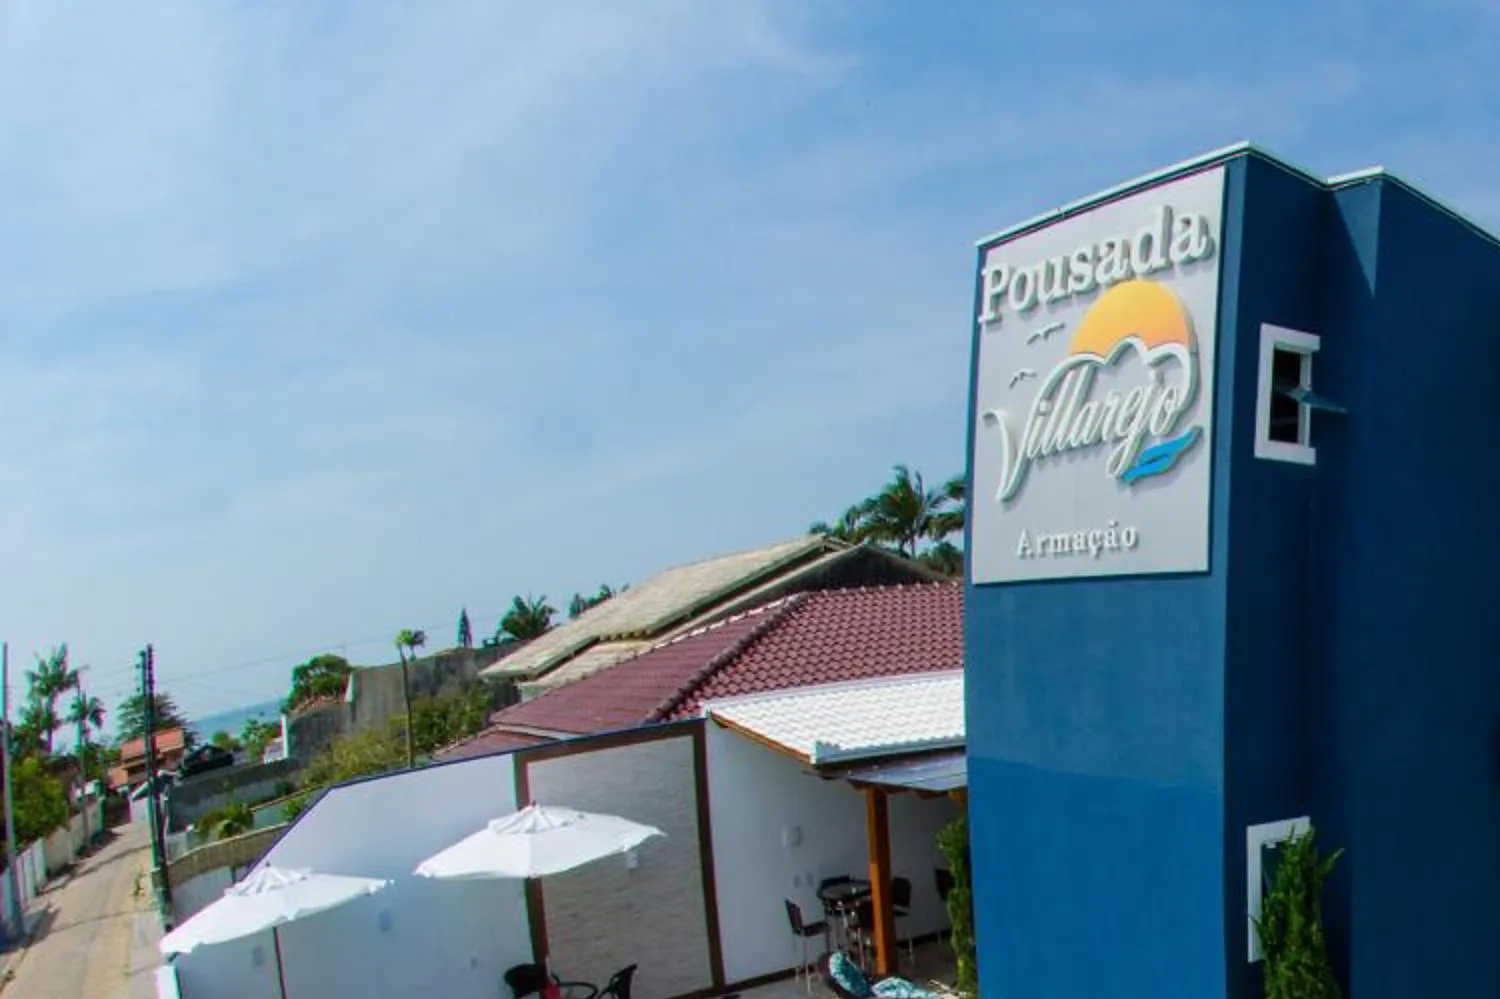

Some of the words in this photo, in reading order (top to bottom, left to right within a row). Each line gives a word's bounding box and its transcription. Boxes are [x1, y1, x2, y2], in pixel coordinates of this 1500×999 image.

[979, 205, 1216, 321] Pousada
[983, 336, 1198, 501] Villarejo
[1017, 522, 1139, 558] Armação
